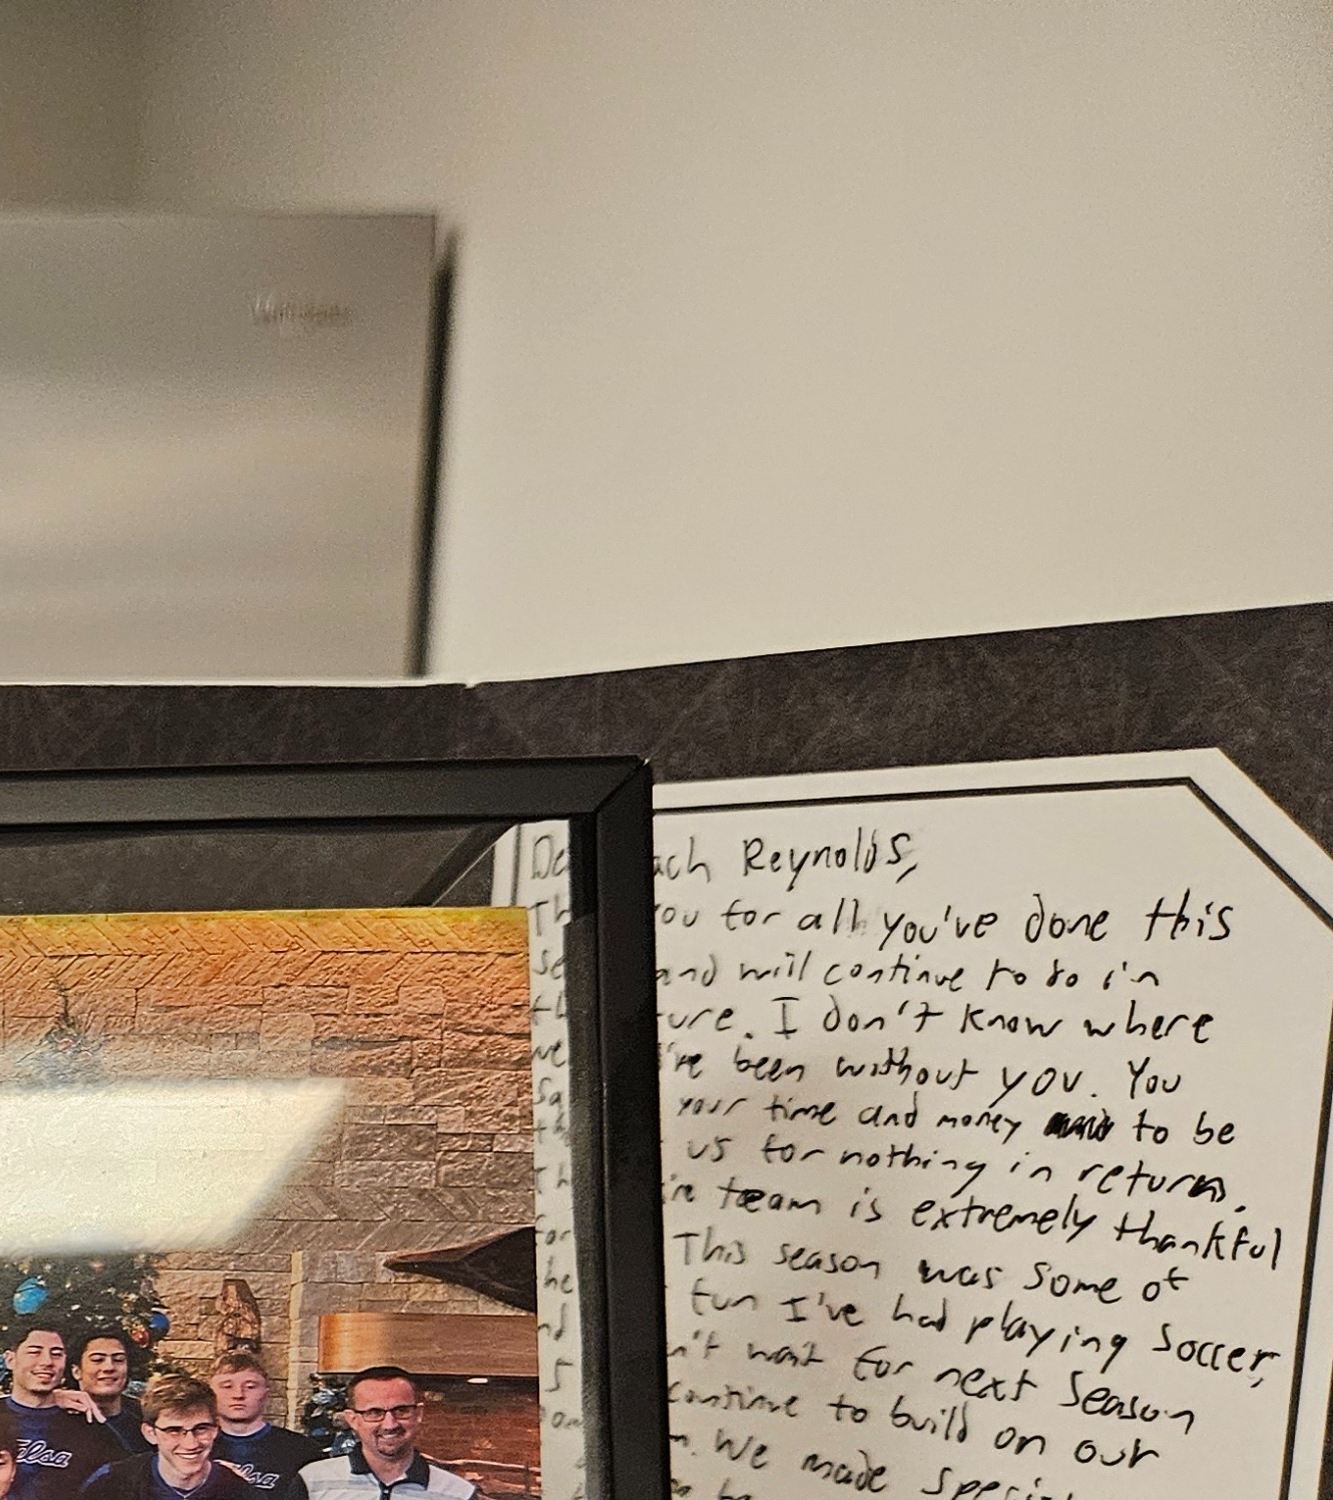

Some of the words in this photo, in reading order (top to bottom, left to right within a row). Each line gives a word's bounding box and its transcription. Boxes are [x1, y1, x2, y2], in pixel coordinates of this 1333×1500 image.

[743, 826, 918, 892] Reynolds,
[721, 898, 781, 930] for
[797, 898, 859, 935] all
[881, 905, 998, 951] you've
[1025, 893, 1110, 942] done
[1145, 887, 1233, 941] this
[740, 952, 813, 984] will
[823, 954, 964, 992] continue
[986, 958, 1027, 991] to
[1046, 958, 1078, 990] do
[1103, 960, 1160, 991] in
[772, 996, 798, 1040] I
[823, 994, 943, 1035] don't
[961, 1002, 1062, 1038] know
[1084, 1001, 1214, 1042] where
[736, 1046, 804, 1083] been
[836, 1046, 978, 1088] without
[990, 1067, 1099, 1108] you.
[1127, 1057, 1181, 1100] You
[677, 1097, 746, 1116] your
[763, 1095, 837, 1127] time
[859, 1091, 918, 1128] and
[937, 1110, 1021, 1144] money
[1132, 1108, 1169, 1144] to
[1194, 1111, 1235, 1145] be
[688, 1136, 731, 1162] us
[762, 1133, 824, 1163] for
[840, 1143, 986, 1198] nothing
[1011, 1152, 1052, 1181] in
[719, 1177, 821, 1213] team
[851, 1187, 882, 1222] is
[912, 1194, 1096, 1243] extremely
[1114, 1209, 1281, 1270] thankful
[673, 1227, 746, 1266] This
[920, 1259, 1003, 1288] was
[1142, 1266, 1189, 1302] of
[692, 1278, 757, 1316] fun
[780, 1292, 864, 1327] I've
[893, 1294, 946, 1332] had
[964, 1299, 1128, 1374] playing
[747, 1341, 823, 1368] wait
[853, 1346, 913, 1381] for
[934, 1367, 1037, 1402] next
[714, 1428, 769, 1470] We
[801, 1449, 887, 1493] made
[827, 1394, 868, 1424] to
[890, 1396, 969, 1443] build
[995, 1427, 1045, 1455] on
[1074, 1438, 1160, 1469] our
